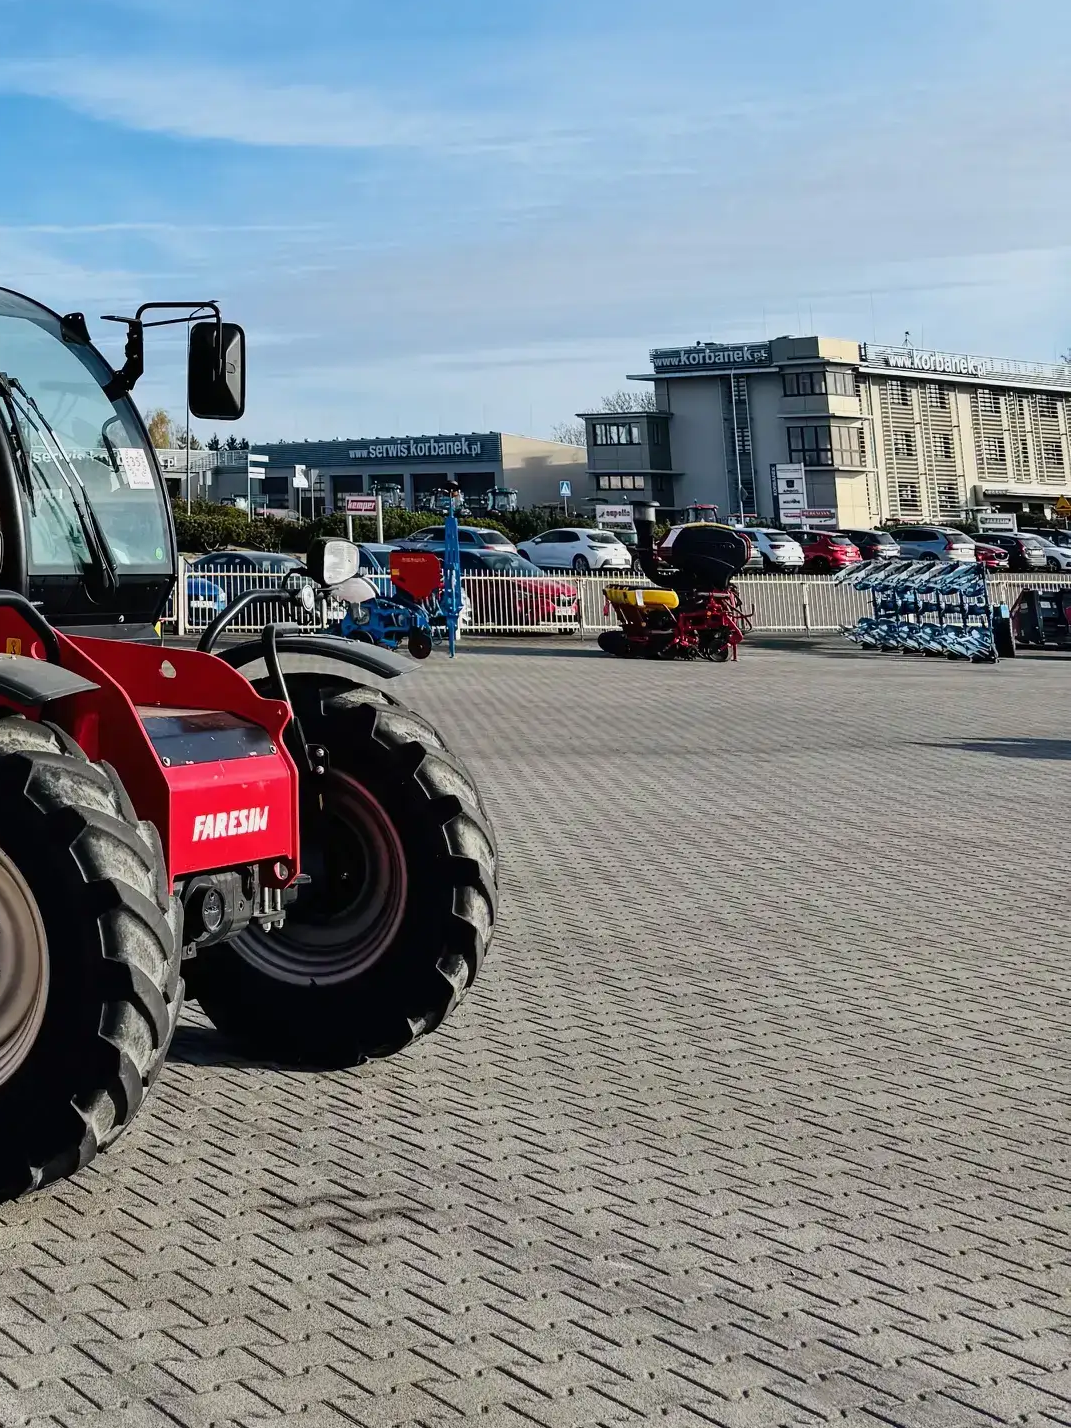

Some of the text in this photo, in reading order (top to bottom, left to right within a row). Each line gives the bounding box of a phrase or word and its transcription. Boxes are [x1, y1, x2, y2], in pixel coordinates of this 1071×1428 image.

[654, 347, 767, 366] www.korbanek.pl
[889, 351, 986, 377] www.korbanek.pl
[349, 437, 481, 458] www.serwis.korbanek.pl
[348, 499, 375, 512] kemper
[192, 806, 269, 842] FARESIN
